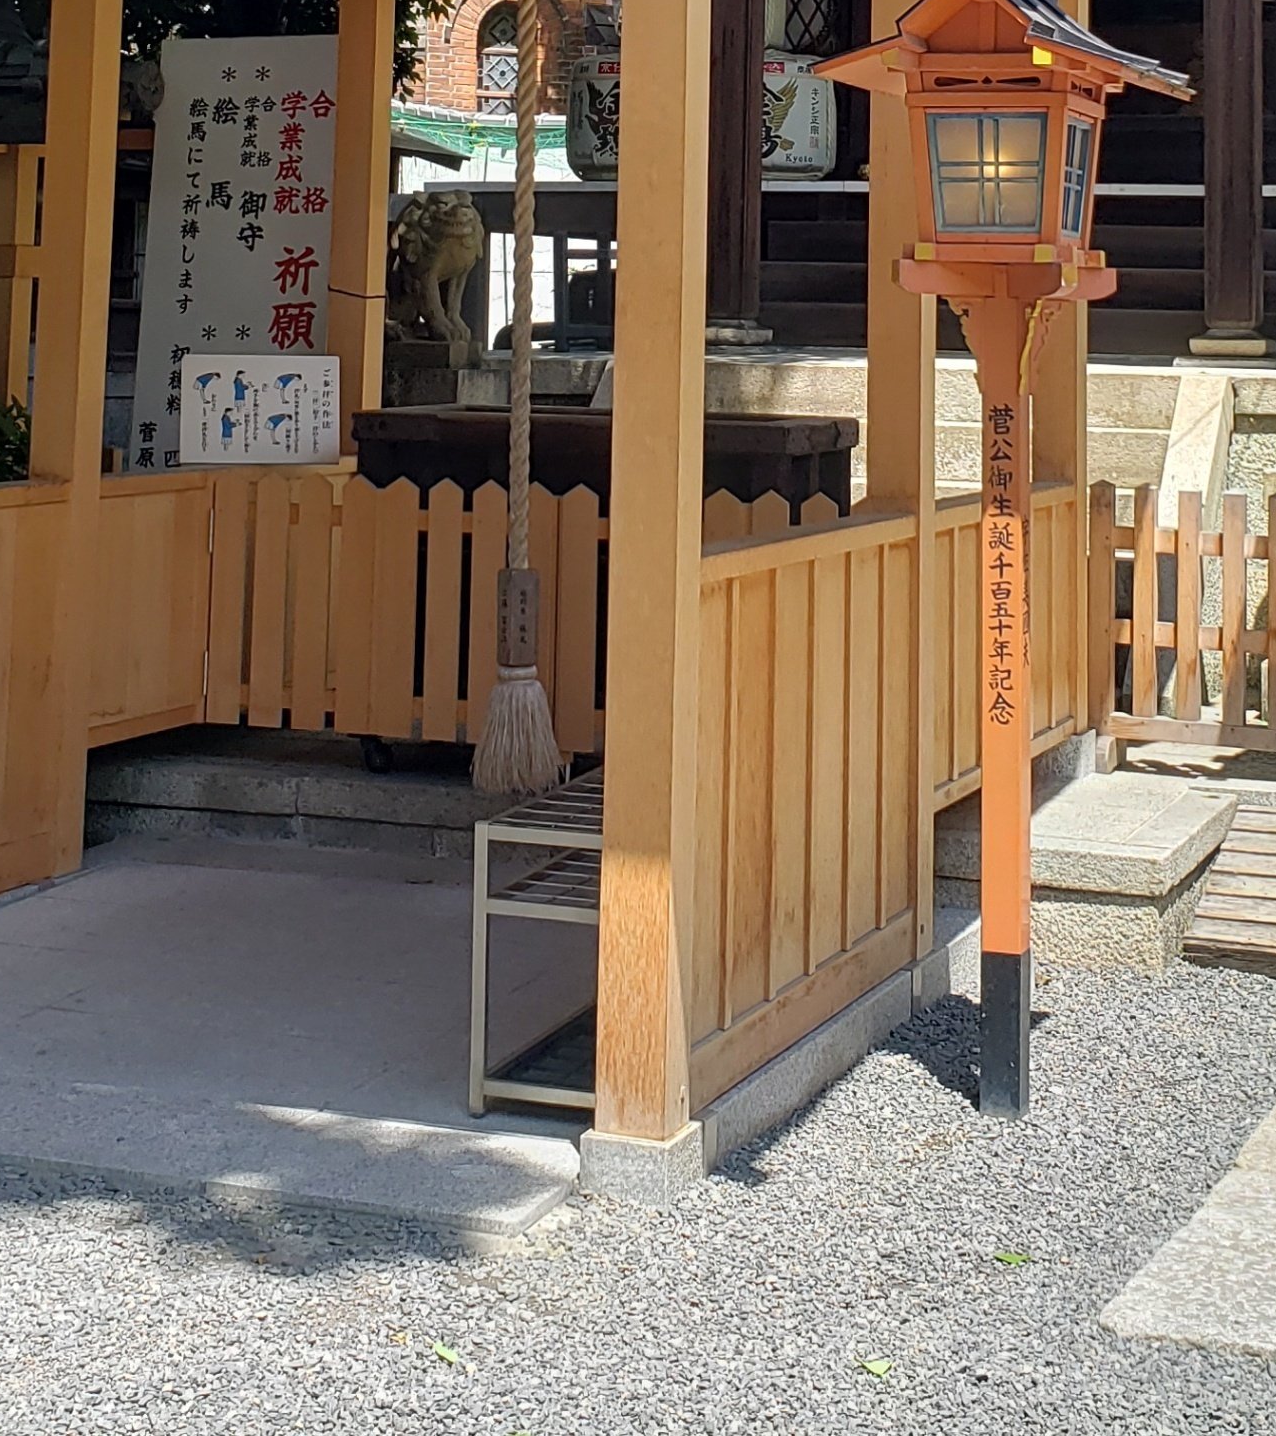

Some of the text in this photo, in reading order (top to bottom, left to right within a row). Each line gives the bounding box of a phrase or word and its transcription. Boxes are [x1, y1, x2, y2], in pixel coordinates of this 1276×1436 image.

[273, 90, 308, 215] 学業成就
[785, 152, 813, 164] Kyoto
[235, 190, 268, 252] 御守
[267, 246, 320, 350] 祈願
[135, 421, 158, 468] 菅原
[987, 403, 1016, 726] 菅公御生誕千百五十年記念
